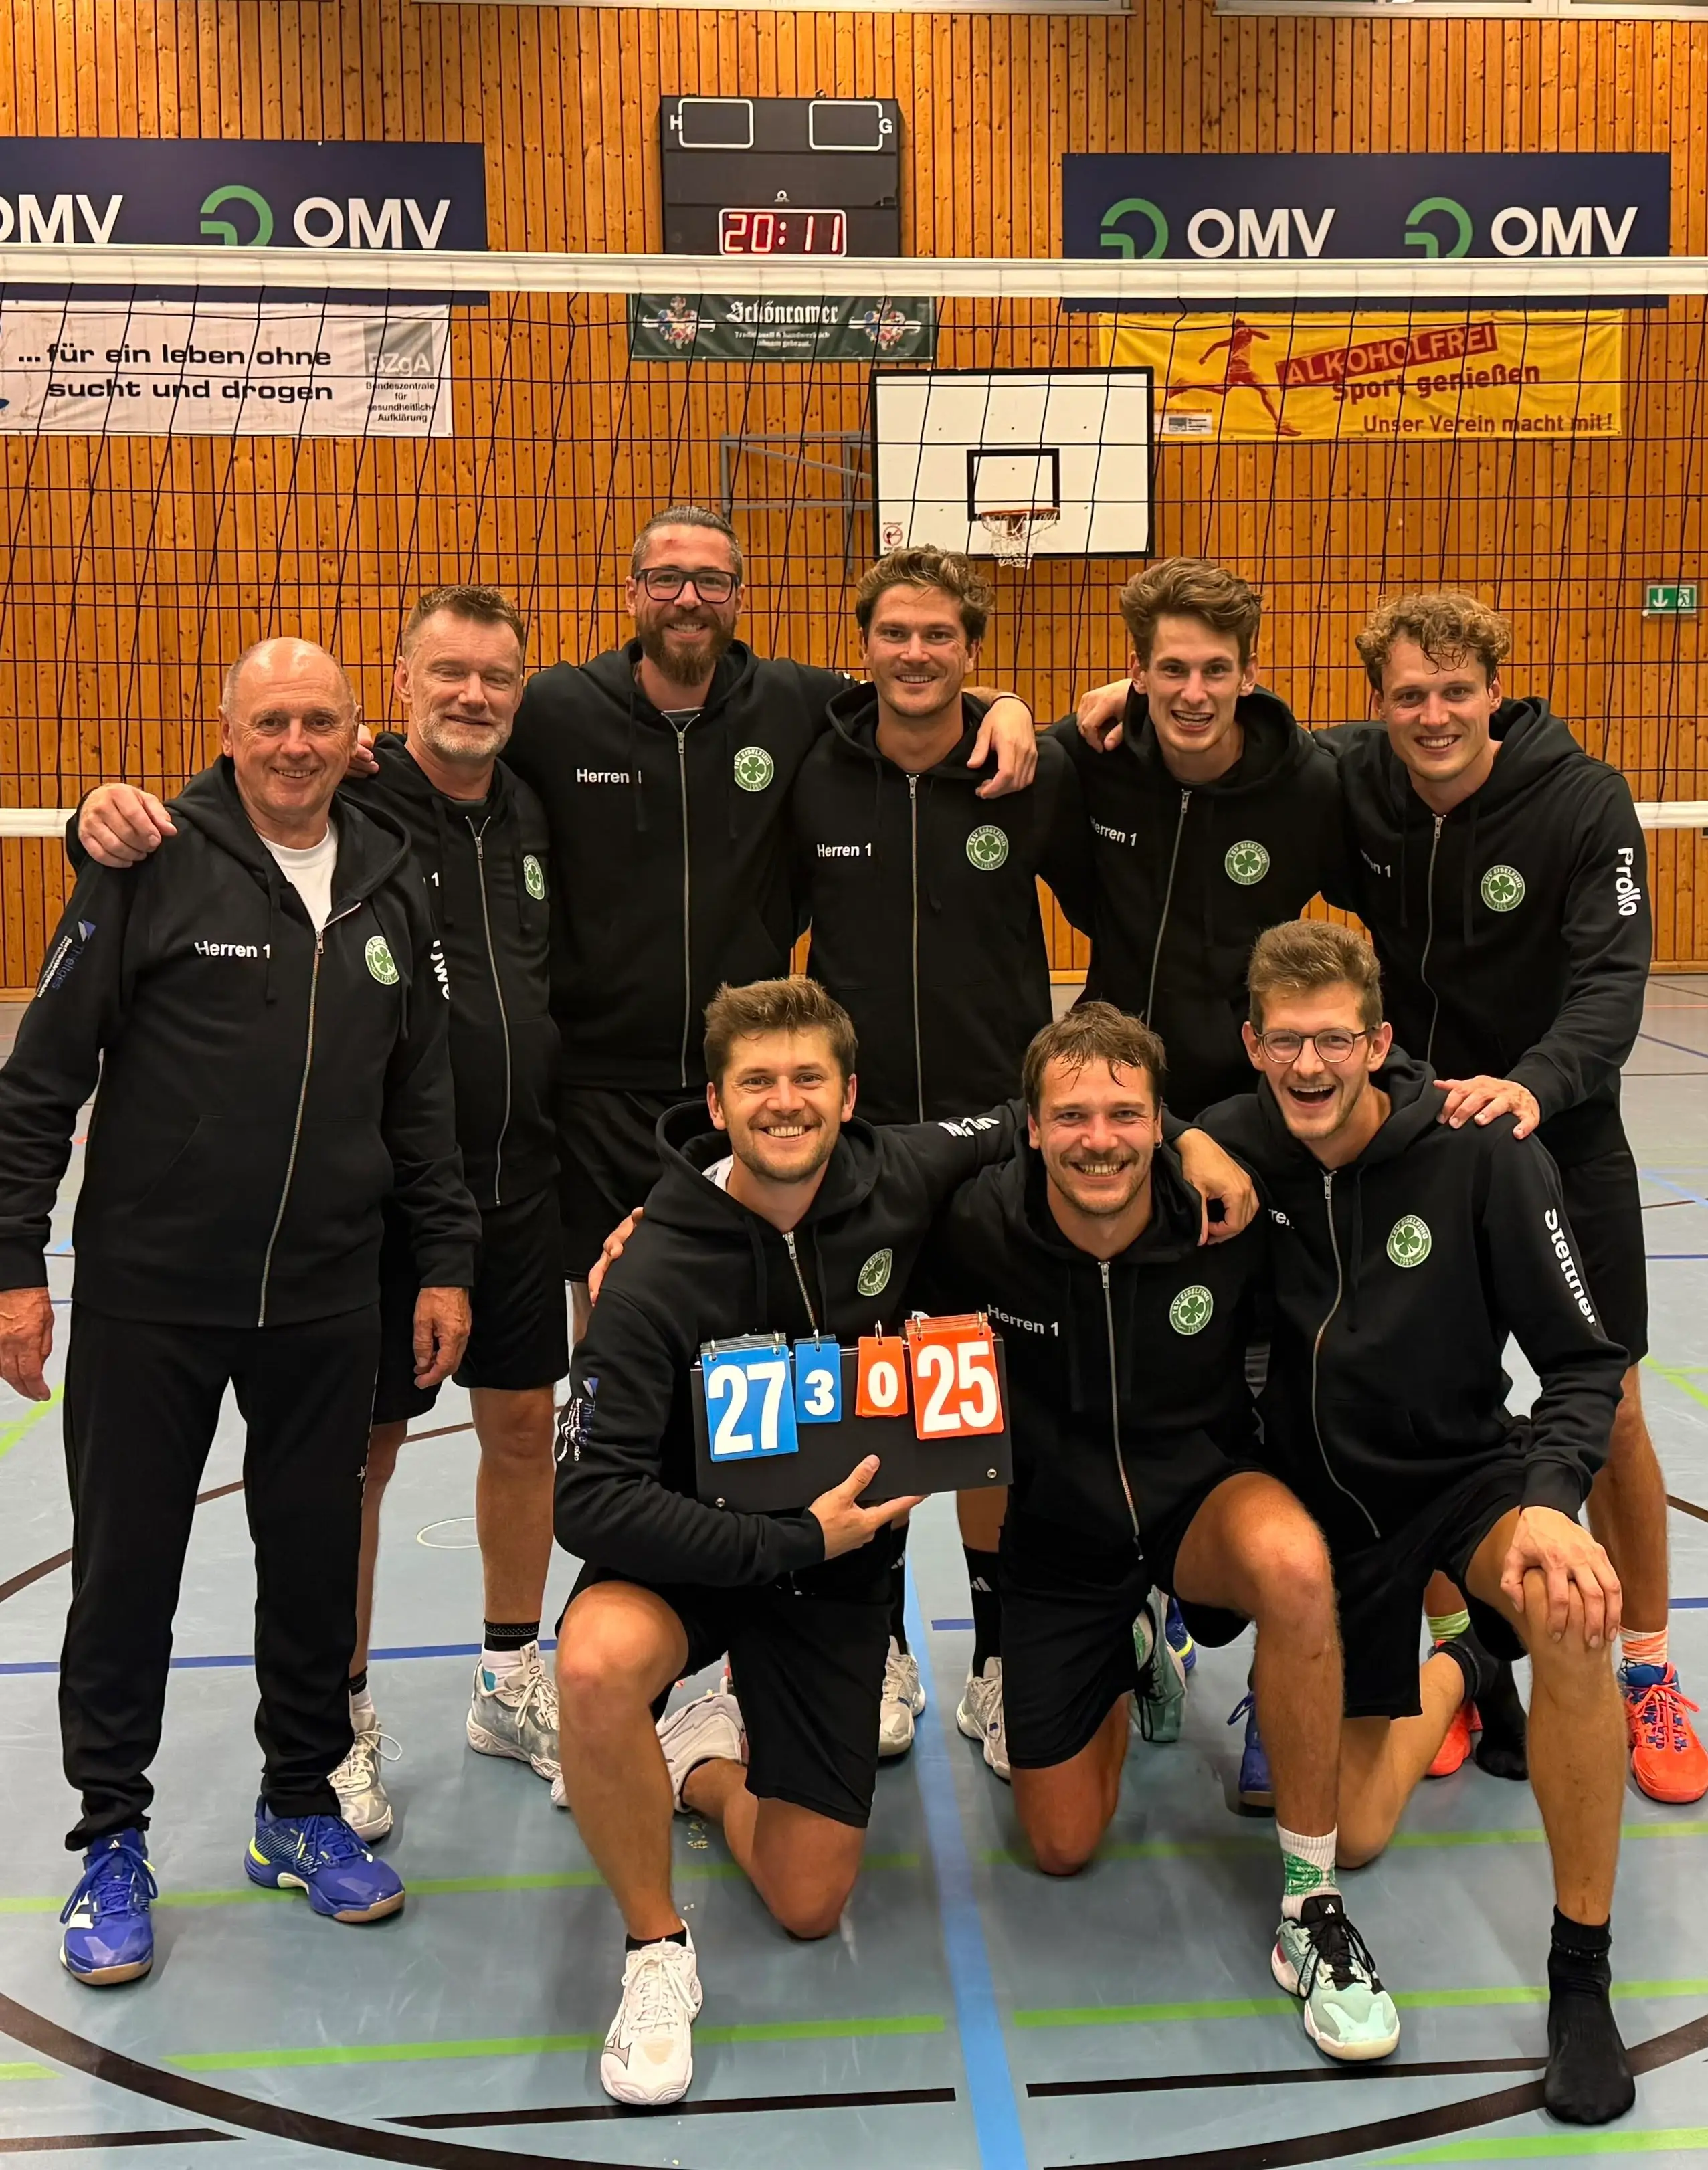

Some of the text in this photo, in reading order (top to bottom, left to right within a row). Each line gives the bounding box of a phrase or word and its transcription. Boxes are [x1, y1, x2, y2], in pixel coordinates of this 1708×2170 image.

[670, 115, 682, 130] H
[879, 118, 892, 134] G
[294, 197, 450, 249] OMV
[725, 214, 840, 252] 20:11
[1188, 207, 1335, 258] OMV
[1491, 207, 1637, 256] OMV
[106, 344, 151, 363] ein
[163, 344, 245, 364] leben
[257, 347, 331, 365] ohne
[1287, 322, 1493, 383] ALKOHOLFREI
[48, 379, 333, 403] sucht und drogen
[1333, 363, 1539, 404] Sport genießen
[1363, 415, 1424, 433] Unser
[1429, 415, 1495, 433] Verein
[1503, 415, 1564, 432] macht
[577, 769, 629, 783] Herren
[817, 842, 872, 857] Herren 1
[1130, 833, 1137, 846] 1
[431, 872, 440, 887] 1
[1385, 865, 1391, 878] 1
[1615, 848, 1642, 916] Prollo
[194, 940, 270, 959] Herren 1
[987, 1304, 1059, 1337] Herren 1
[804, 1369, 835, 1415] 3
[868, 1361, 898, 1408] 0
[917, 1341, 998, 1433] 25
[708, 1361, 786, 1454] 27
